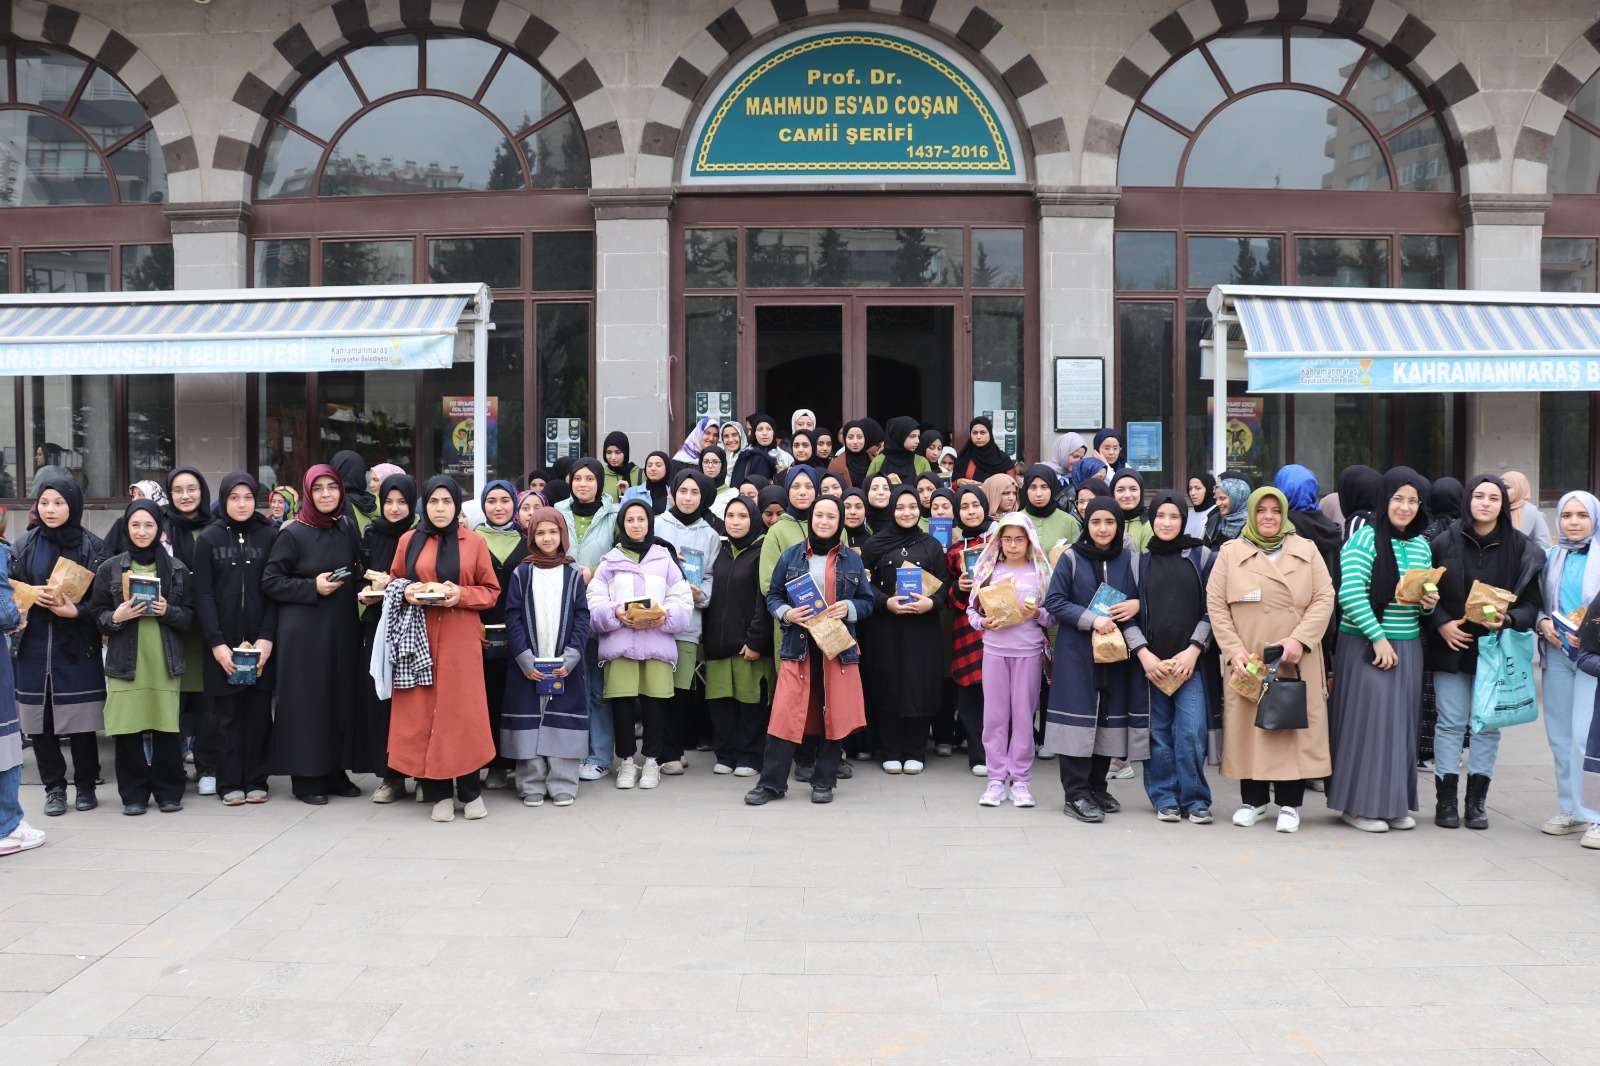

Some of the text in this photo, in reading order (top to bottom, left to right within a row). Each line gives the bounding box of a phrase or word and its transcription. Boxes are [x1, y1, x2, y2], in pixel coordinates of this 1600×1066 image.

[807, 68, 902, 85] Prof. Dr.
[746, 95, 958, 119] MAHMUD ES'AD COŞAN
[779, 122, 913, 145] CAMİİ ŞERİFİ
[906, 145, 989, 158] 1437-2016
[51, 341, 182, 370] BÜYÜKŞEHİR
[188, 338, 306, 367] BELEDİYESİ
[331, 346, 388, 355] Kahramanmaraş
[1393, 361, 1580, 387] KAHRAMANMARAŞ
